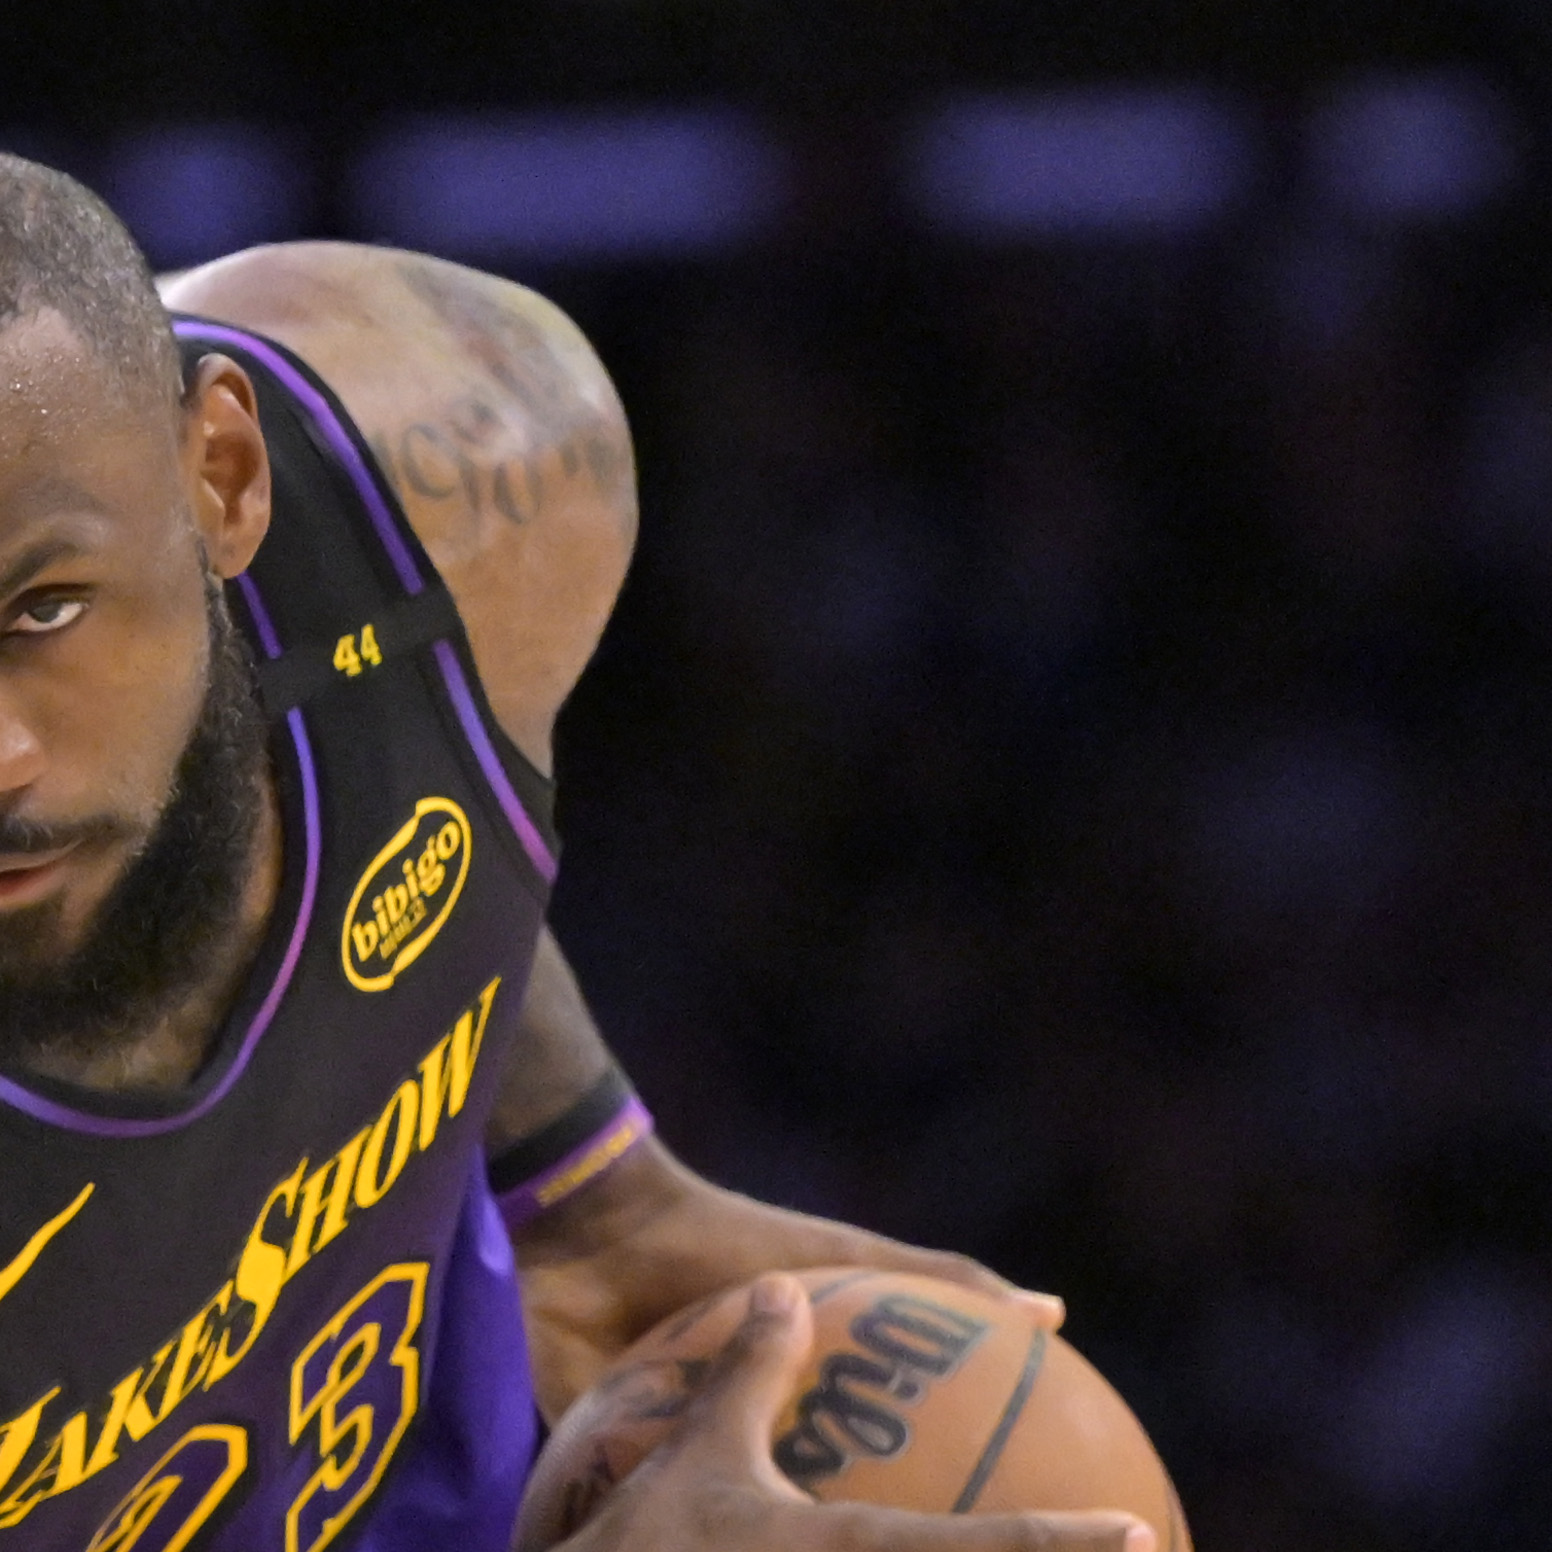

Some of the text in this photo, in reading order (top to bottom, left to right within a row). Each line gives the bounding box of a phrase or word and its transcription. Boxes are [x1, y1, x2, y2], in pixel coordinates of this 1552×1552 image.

[333, 624, 382, 677] 44
[351, 820, 461, 963] bibigo
[772, 1296, 990, 1497] Wils
